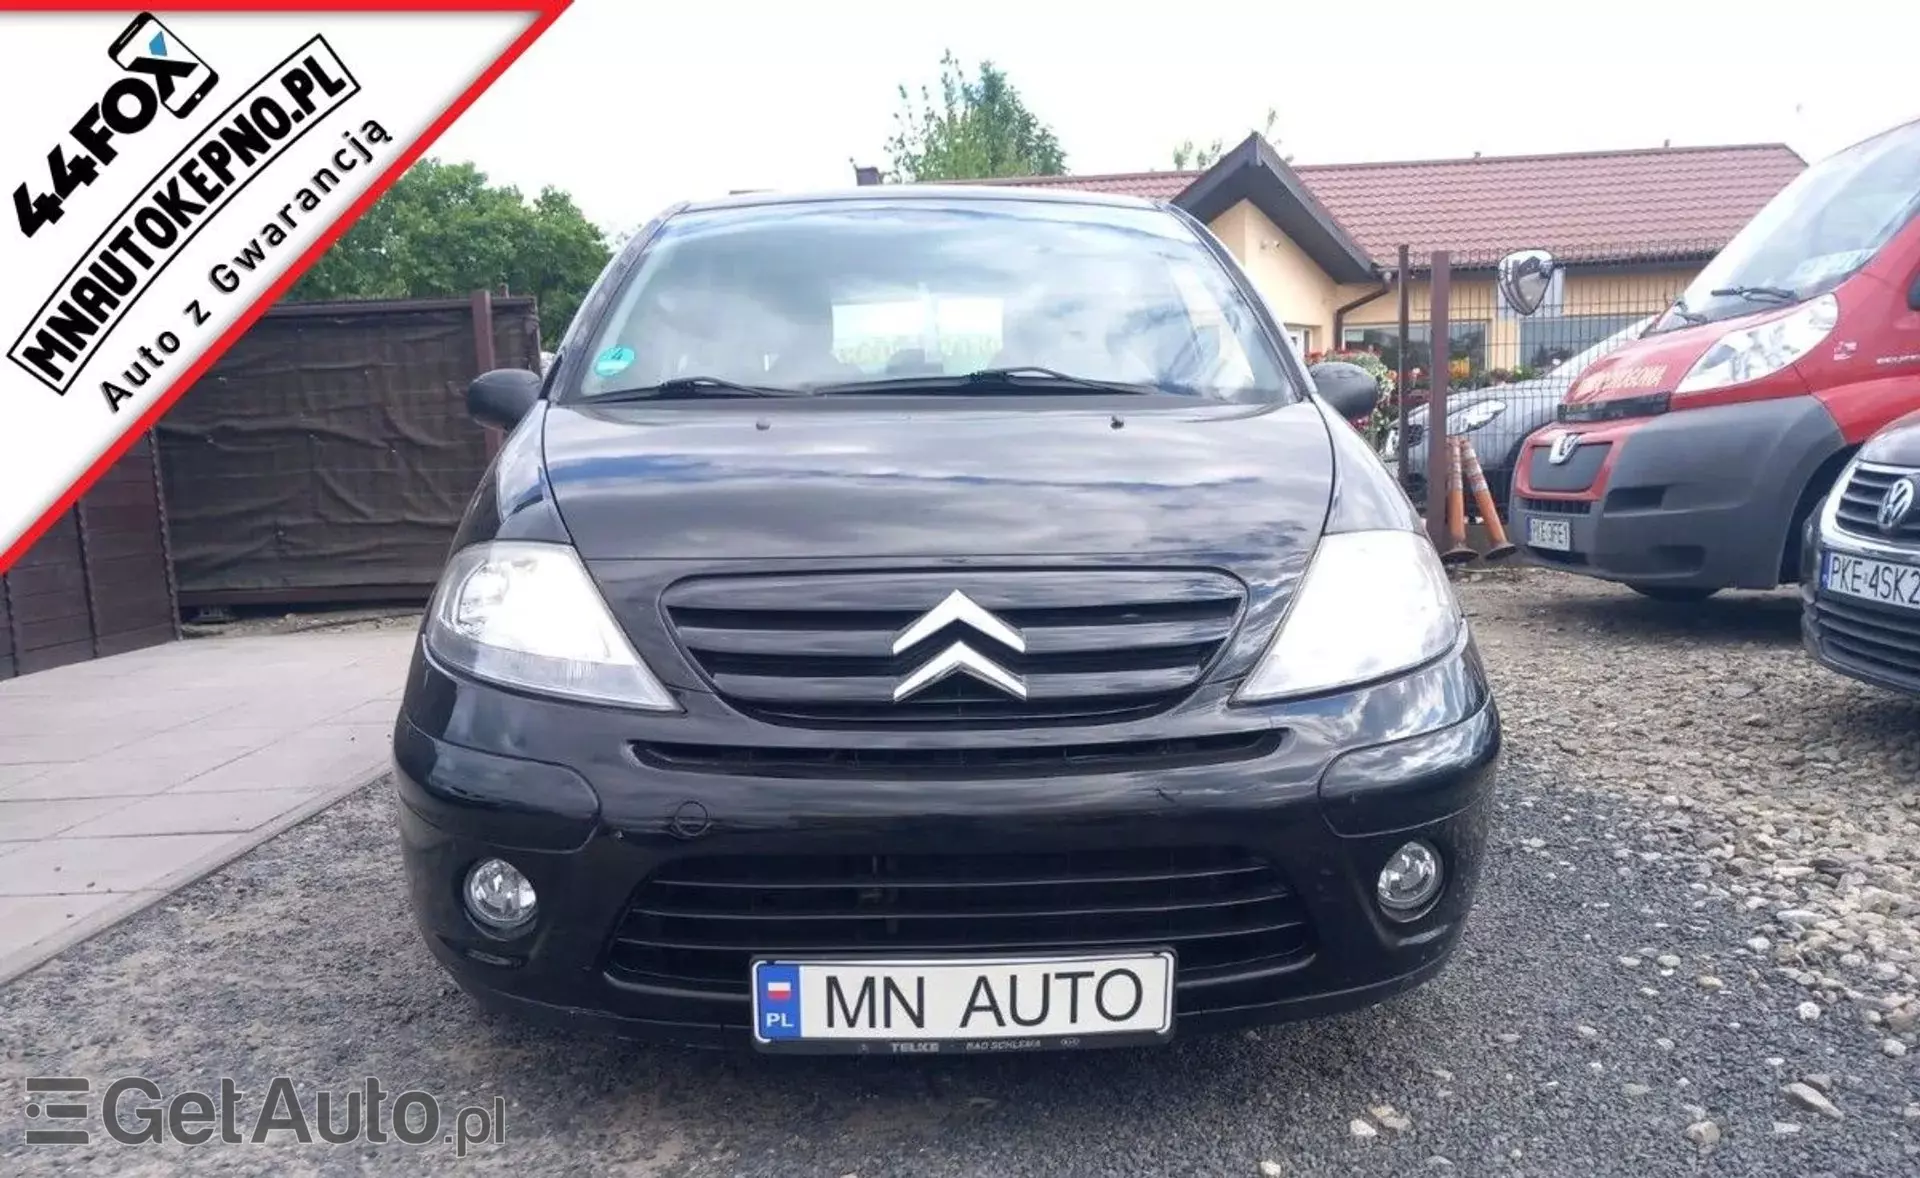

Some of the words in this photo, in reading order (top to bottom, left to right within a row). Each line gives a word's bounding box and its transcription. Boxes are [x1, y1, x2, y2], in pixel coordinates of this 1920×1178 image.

[1830, 555, 1863, 593] PKE
[826, 975, 925, 1029] MN
[959, 968, 1143, 1028] AUTO
[766, 1012, 794, 1028] PL
